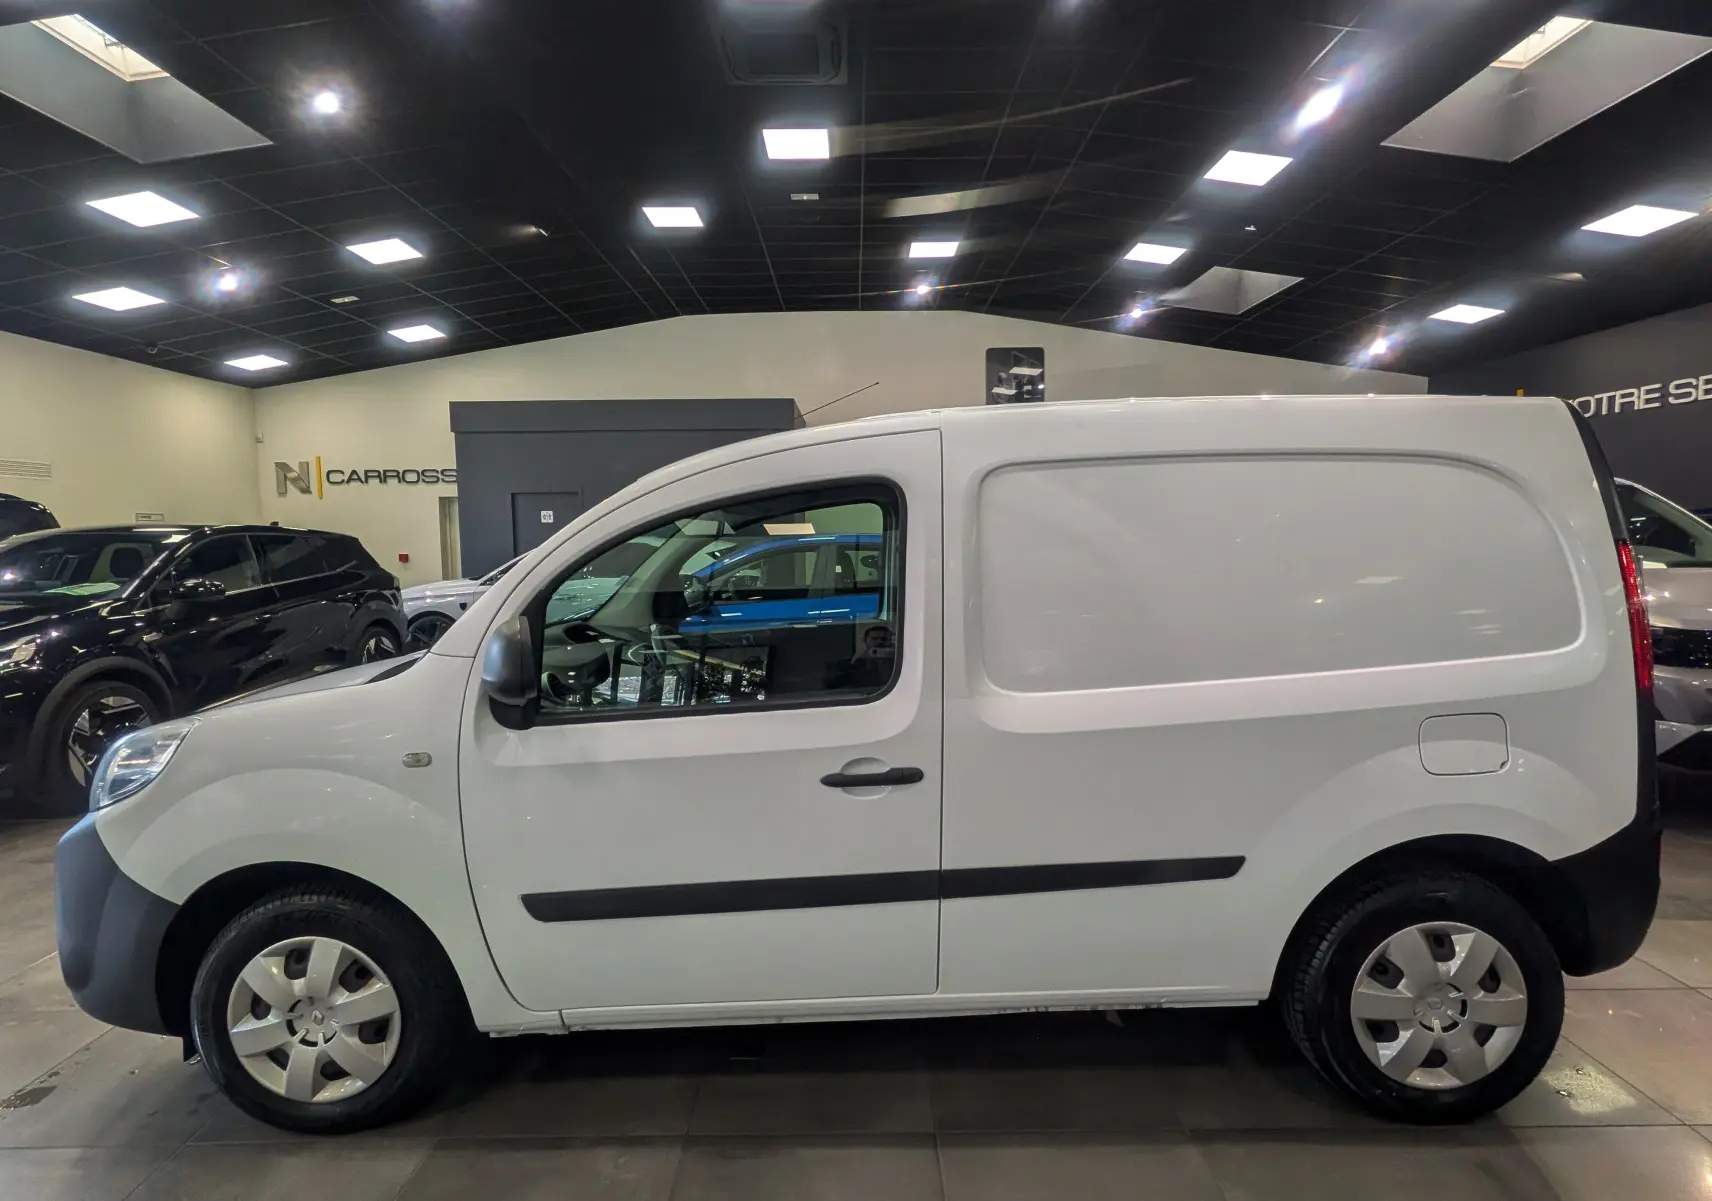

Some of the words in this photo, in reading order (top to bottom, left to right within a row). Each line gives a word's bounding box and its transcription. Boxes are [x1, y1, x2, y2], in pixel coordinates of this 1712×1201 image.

[1568, 383, 1663, 418] OTRE
[274, 461, 312, 494] N
[325, 468, 458, 485] CARROSS
